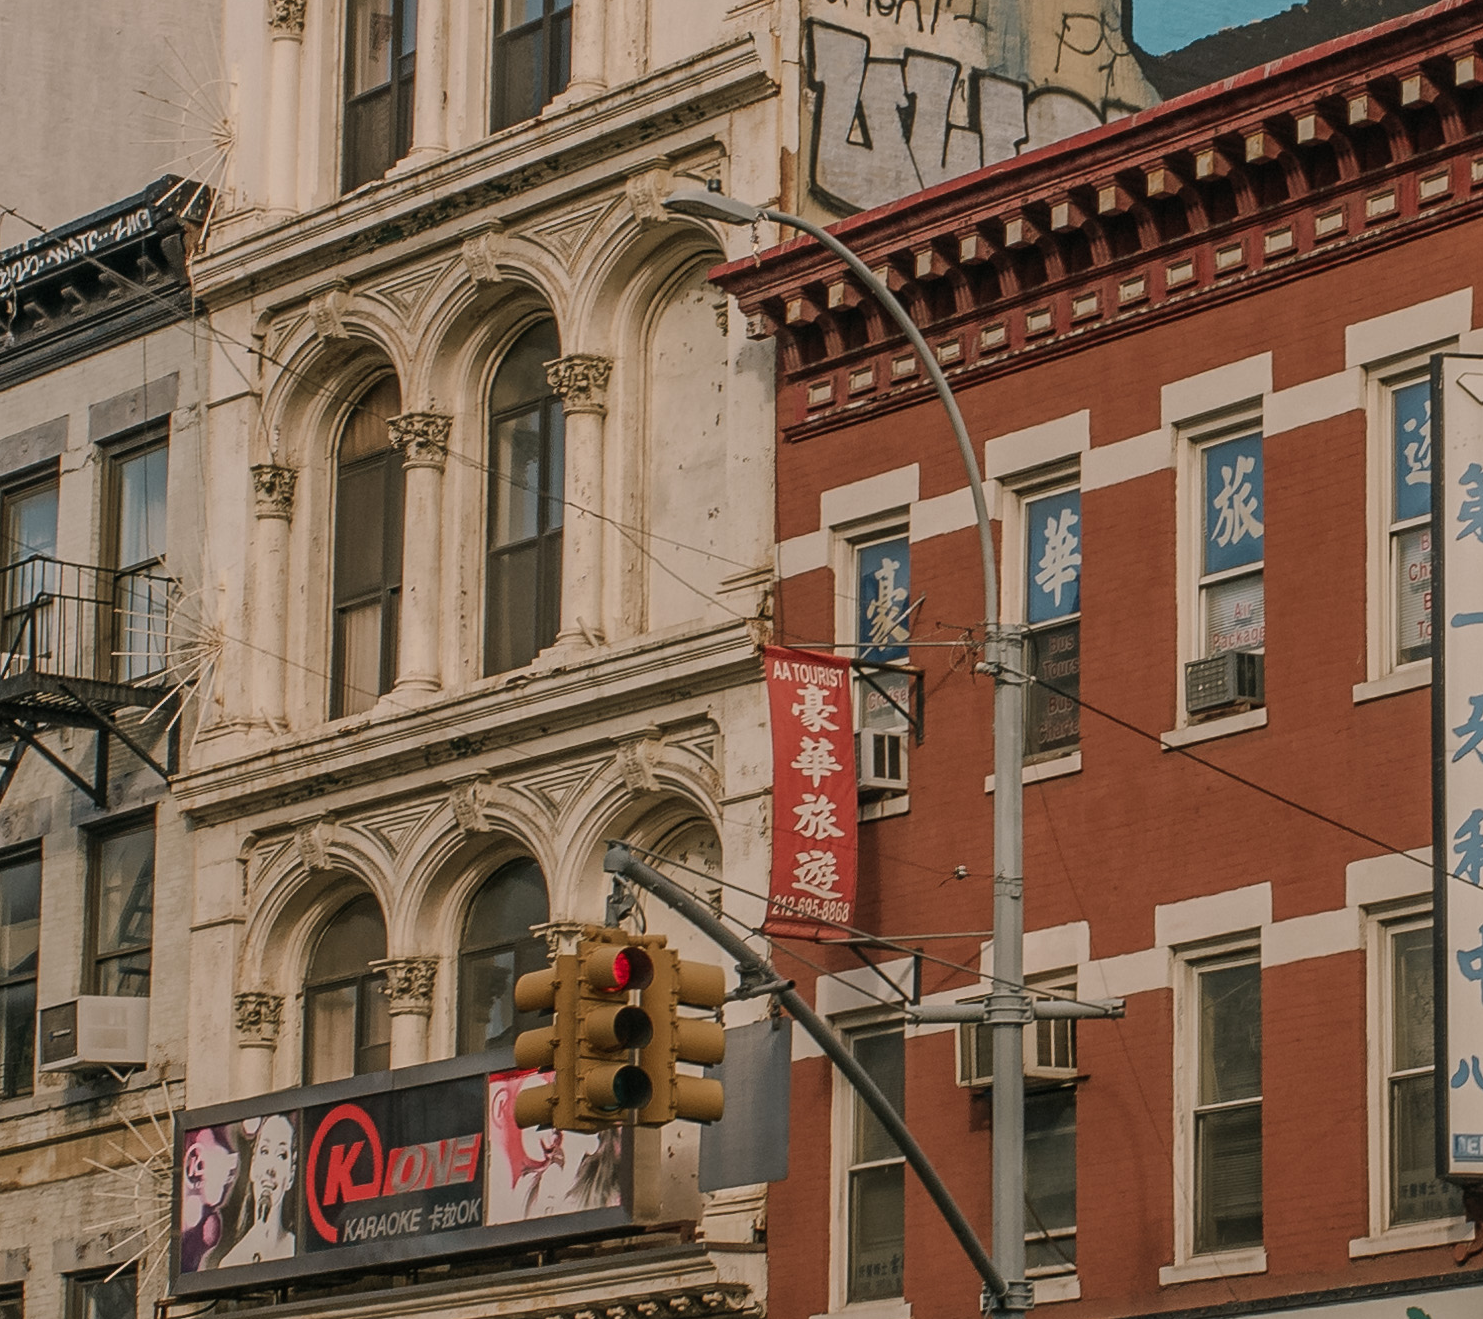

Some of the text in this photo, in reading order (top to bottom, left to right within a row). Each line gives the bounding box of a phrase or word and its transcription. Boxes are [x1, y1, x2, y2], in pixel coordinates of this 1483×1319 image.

[1234, 599, 1253, 620] Air
[772, 660, 844, 688] AA TOURIST
[790, 685, 846, 900] 豪華旅遊
[771, 894, 850, 924] 212-695-8868
[386, 1134, 483, 1195] ONE
[342, 1196, 482, 1242] KARAOKE 卡拉OK
